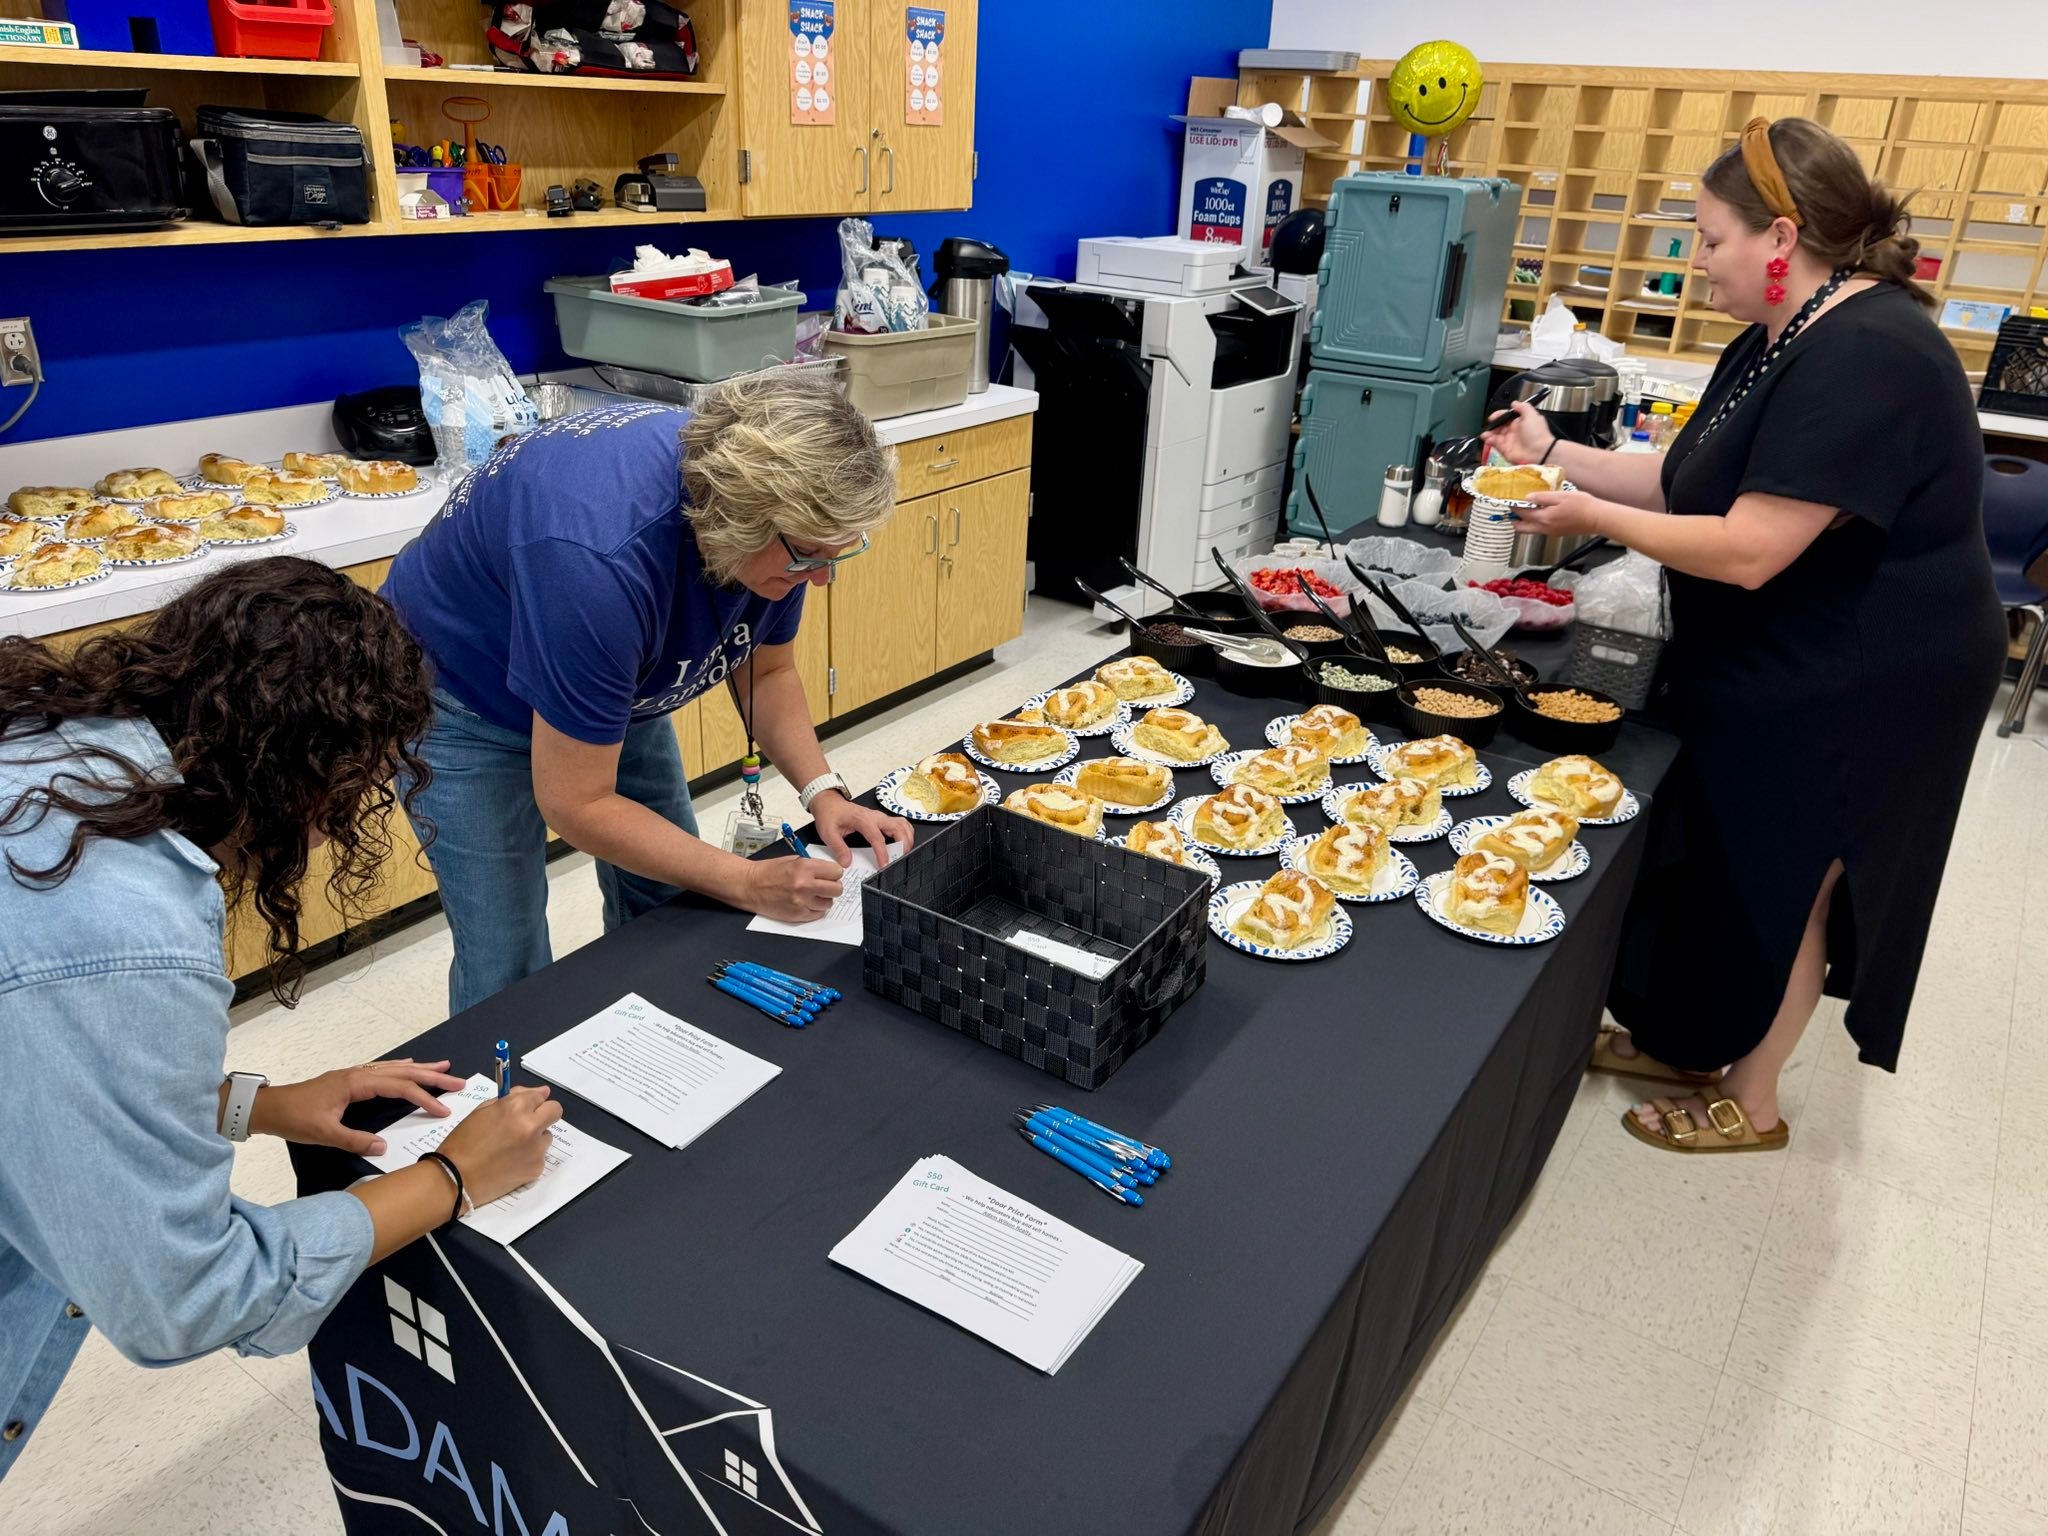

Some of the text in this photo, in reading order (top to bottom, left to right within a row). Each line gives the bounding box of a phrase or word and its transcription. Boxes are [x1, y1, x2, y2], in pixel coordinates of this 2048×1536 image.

[800, 21, 824, 33] SHACK
[915, 29, 936, 40] SHACK
[1190, 136, 1204, 144] USE
[1206, 137, 1221, 146] LID:
[1204, 197, 1235, 211] 1000ct
[1193, 210, 1241, 226] Foam Cups
[671, 659, 693, 689] I
[733, 622, 752, 646] a
[926, 1171, 943, 1181] $50
[912, 1179, 950, 1193] Gift Card
[1007, 1204, 1024, 1218] Prize
[974, 1199, 986, 1208] help
[986, 1204, 1011, 1219] educators
[1022, 1220, 1032, 1229] and
[1041, 1230, 1060, 1243] homes
